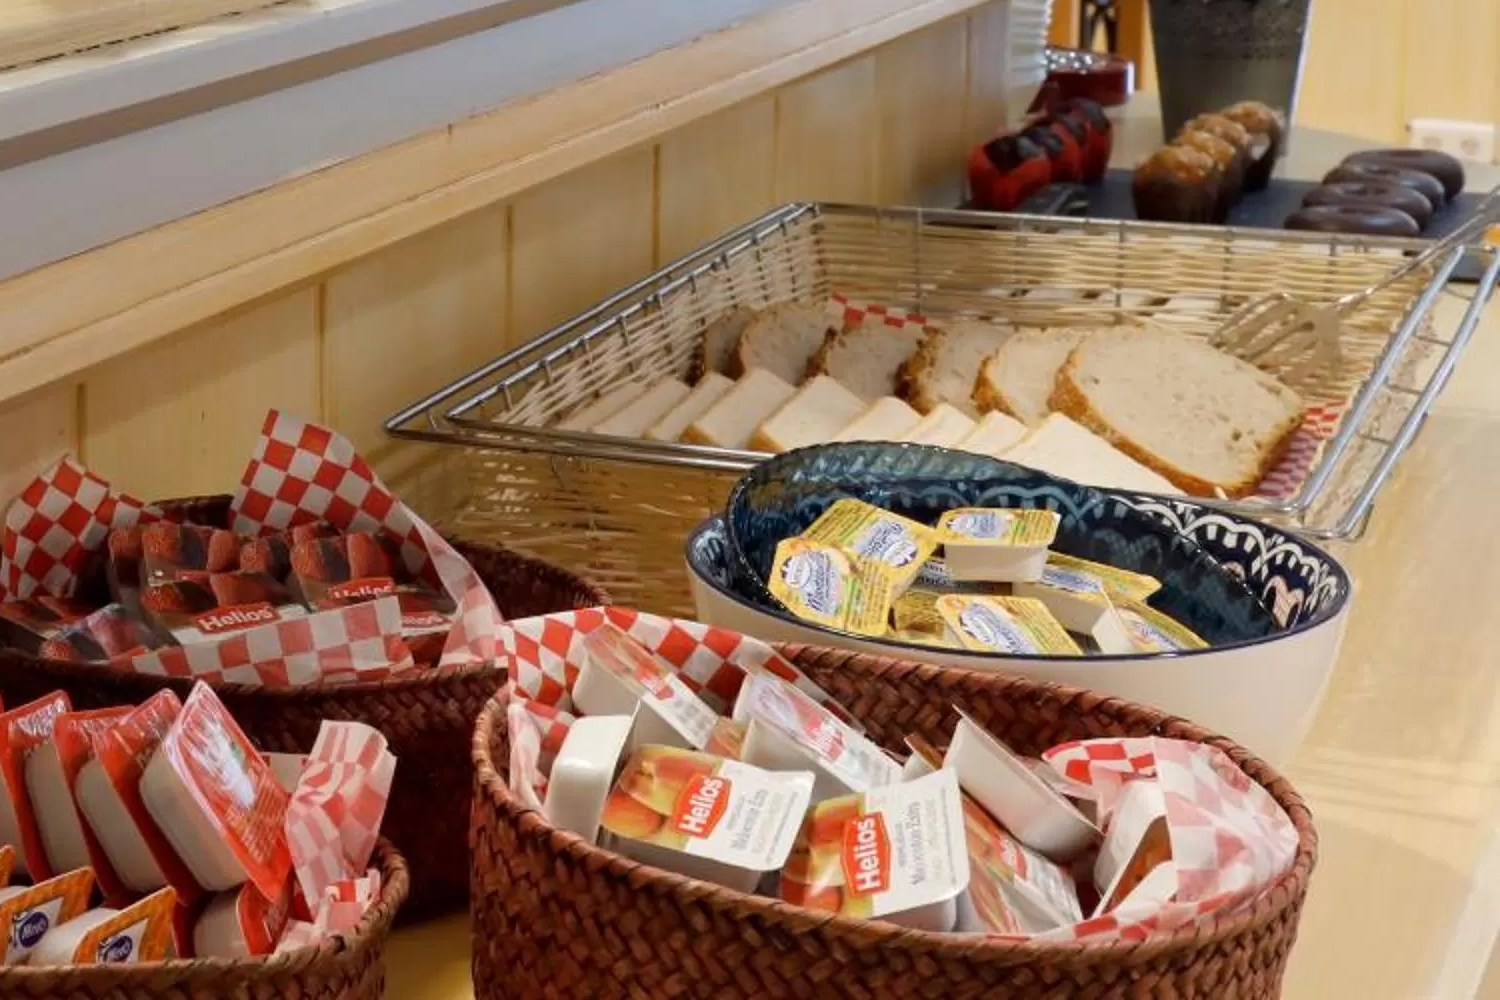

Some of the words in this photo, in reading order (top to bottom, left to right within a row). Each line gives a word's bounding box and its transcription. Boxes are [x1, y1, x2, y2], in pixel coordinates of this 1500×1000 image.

[199, 606, 275, 631] Helios
[678, 776, 724, 835] Helios
[856, 814, 882, 891] Helios
